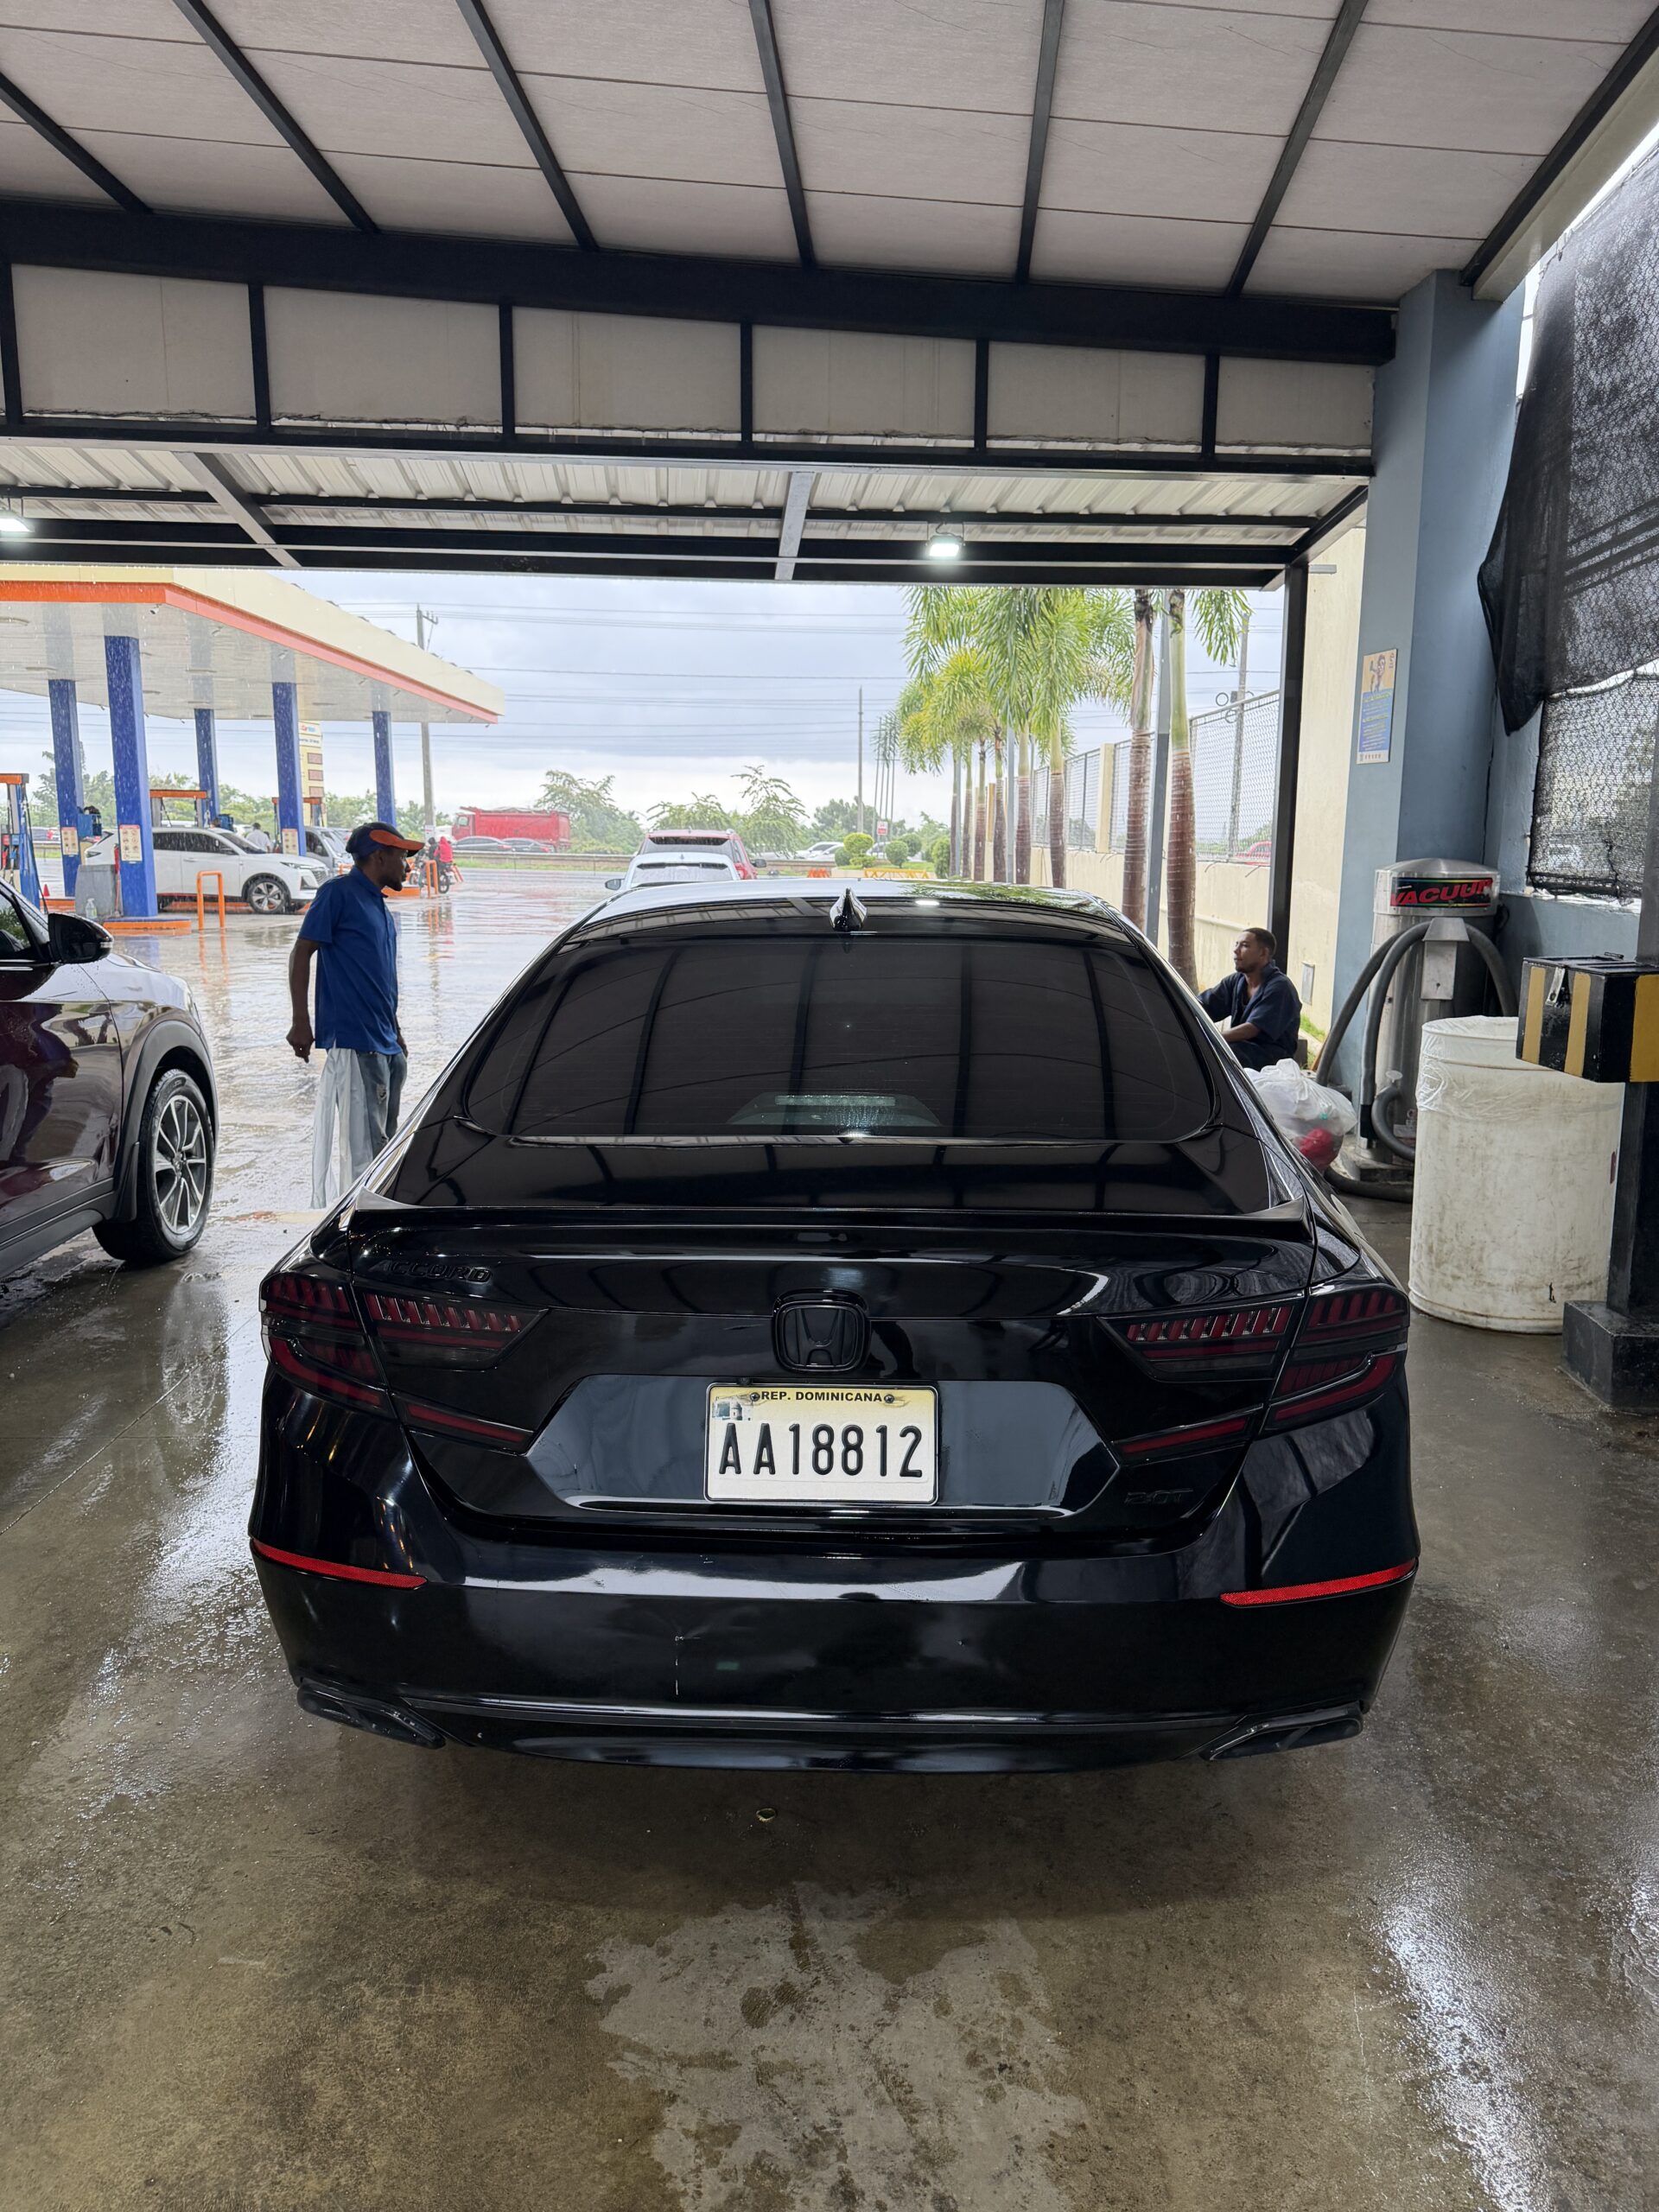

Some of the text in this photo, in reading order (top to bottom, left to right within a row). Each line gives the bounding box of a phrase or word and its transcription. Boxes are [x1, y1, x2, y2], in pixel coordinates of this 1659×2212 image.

[368, 1260, 492, 1284] ACCORD
[761, 1391, 883, 1402] REP. DOMINICANA
[718, 1422, 923, 1478] AA18812
